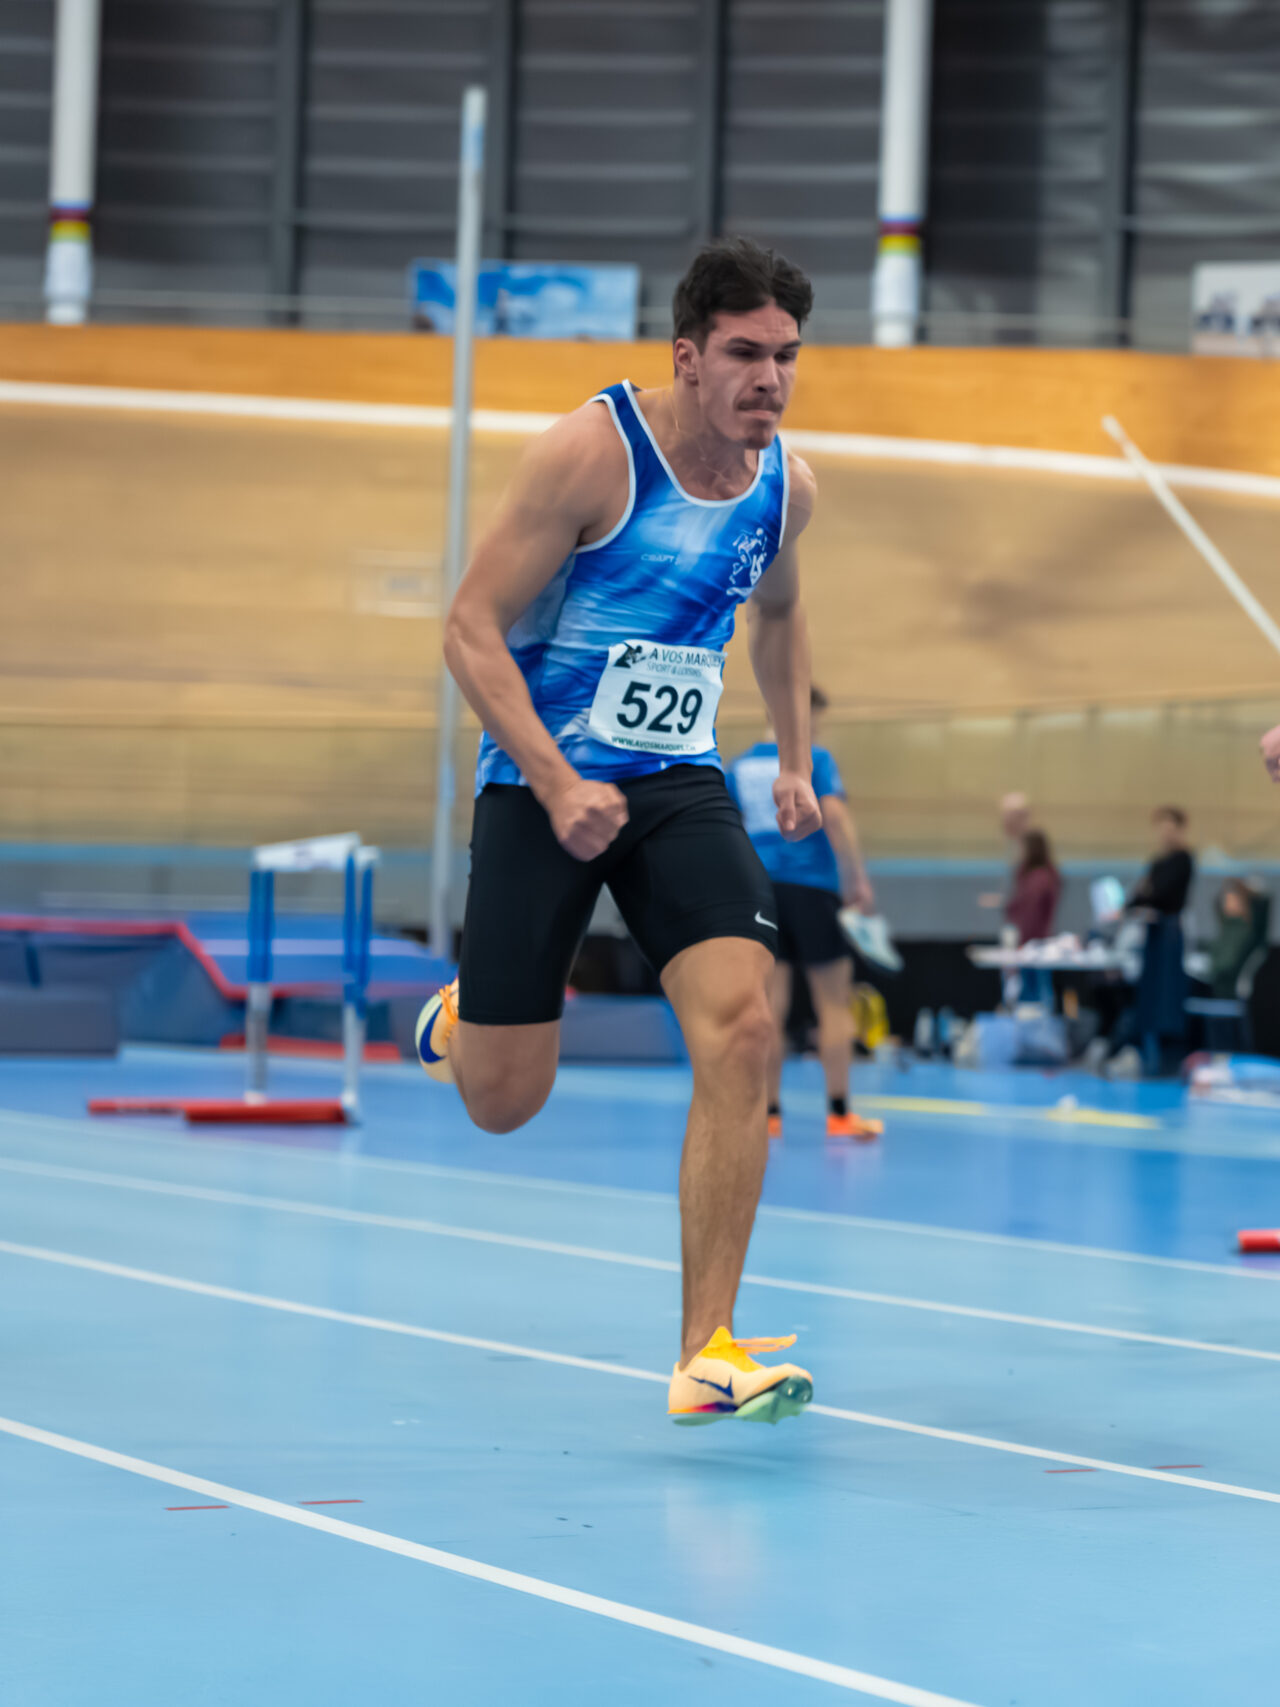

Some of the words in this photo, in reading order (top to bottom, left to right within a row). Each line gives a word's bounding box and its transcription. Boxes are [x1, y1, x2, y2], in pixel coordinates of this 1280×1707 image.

[649, 647, 659, 660] A
[662, 649, 684, 664] VOS
[616, 681, 703, 735] 529
